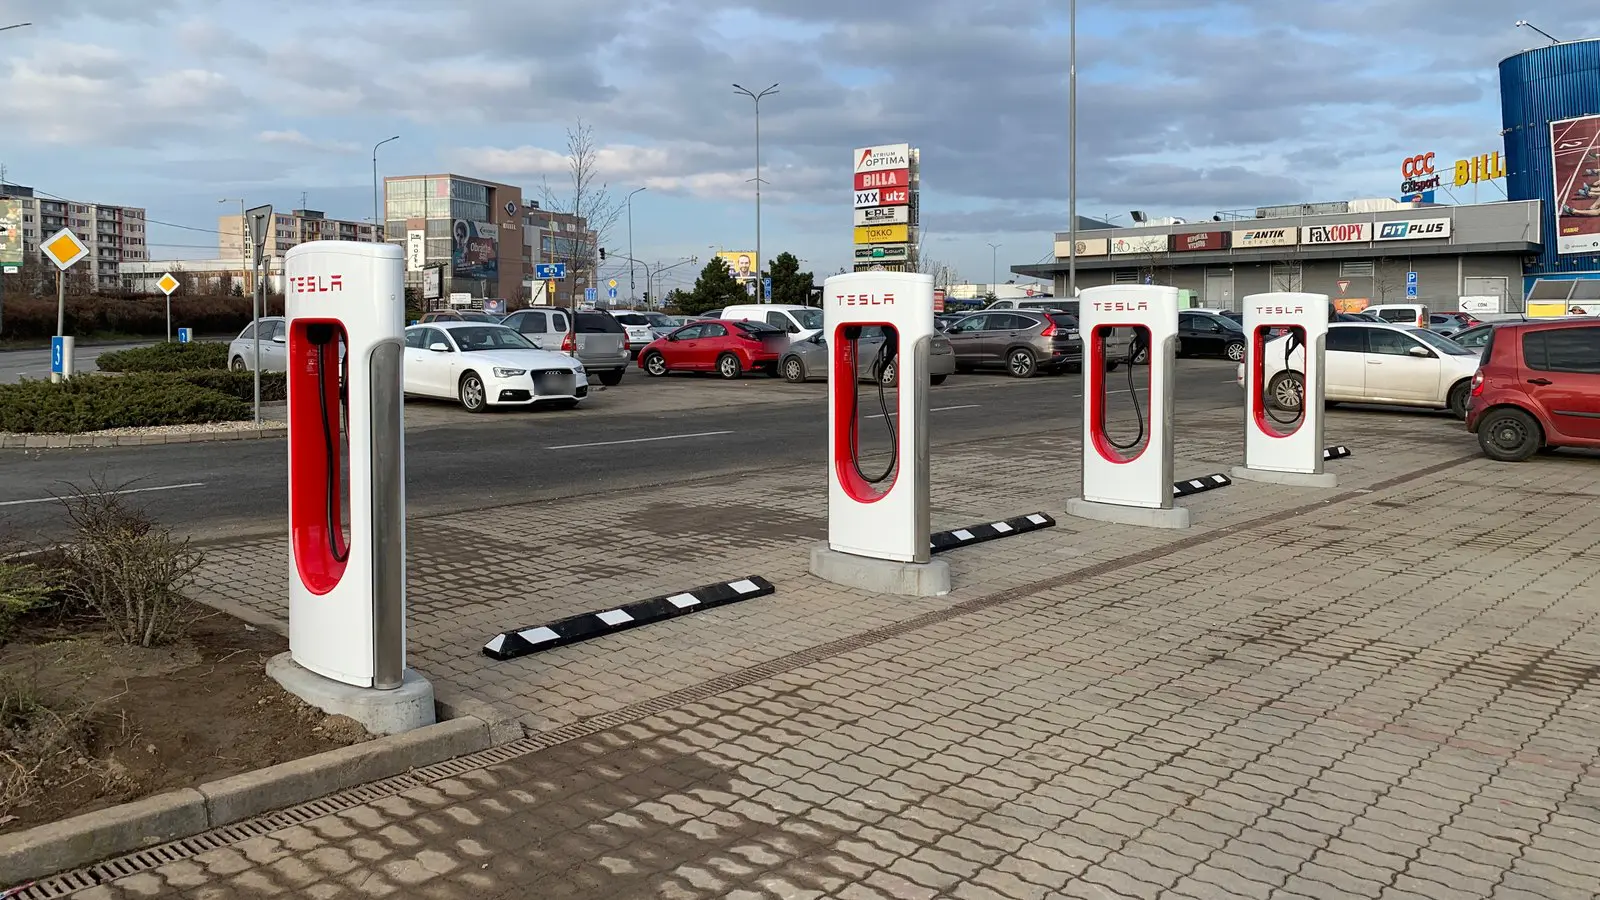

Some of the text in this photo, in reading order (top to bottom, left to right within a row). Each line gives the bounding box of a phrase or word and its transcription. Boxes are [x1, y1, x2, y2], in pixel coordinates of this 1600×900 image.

[866, 156, 905, 167] OPTIMA
[1402, 152, 1435, 178] CCC
[1455, 151, 1507, 187] BILL
[863, 172, 896, 187] BILLA
[1253, 230, 1285, 239] ANTIK
[1383, 223, 1444, 236] FIT PLUS
[290, 275, 342, 293] TESLA
[837, 293, 894, 306] TESLA
[1094, 302, 1147, 311] TESLA
[1256, 307, 1303, 315] TESLA
[55, 345, 61, 366] 3
